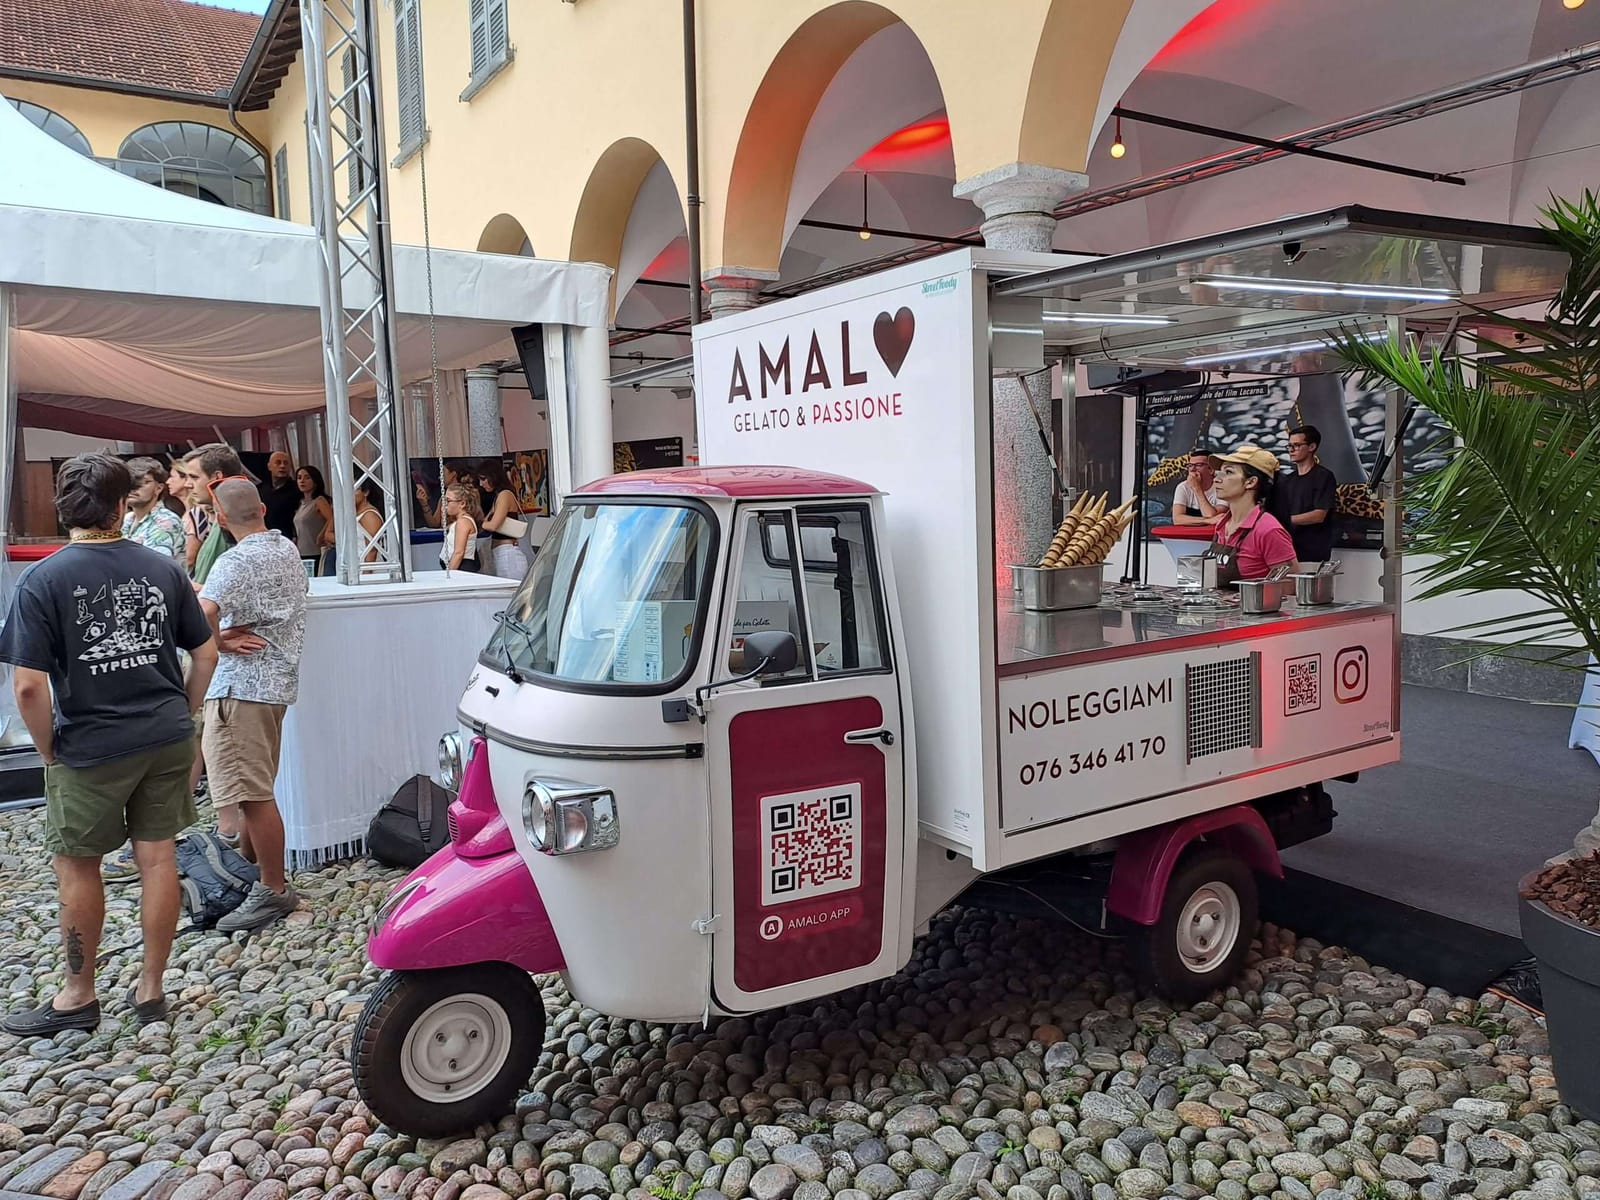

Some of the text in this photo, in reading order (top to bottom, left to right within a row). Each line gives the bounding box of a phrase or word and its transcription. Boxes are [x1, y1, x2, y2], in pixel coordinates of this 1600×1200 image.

[734, 393, 903, 432] GELATO & PASSIONE
[1008, 677, 1172, 734] NOLEGGIAMI
[1020, 735, 1166, 785] 076 346 41 70
[788, 912, 828, 930] AMALO
[829, 907, 850, 921] APP
